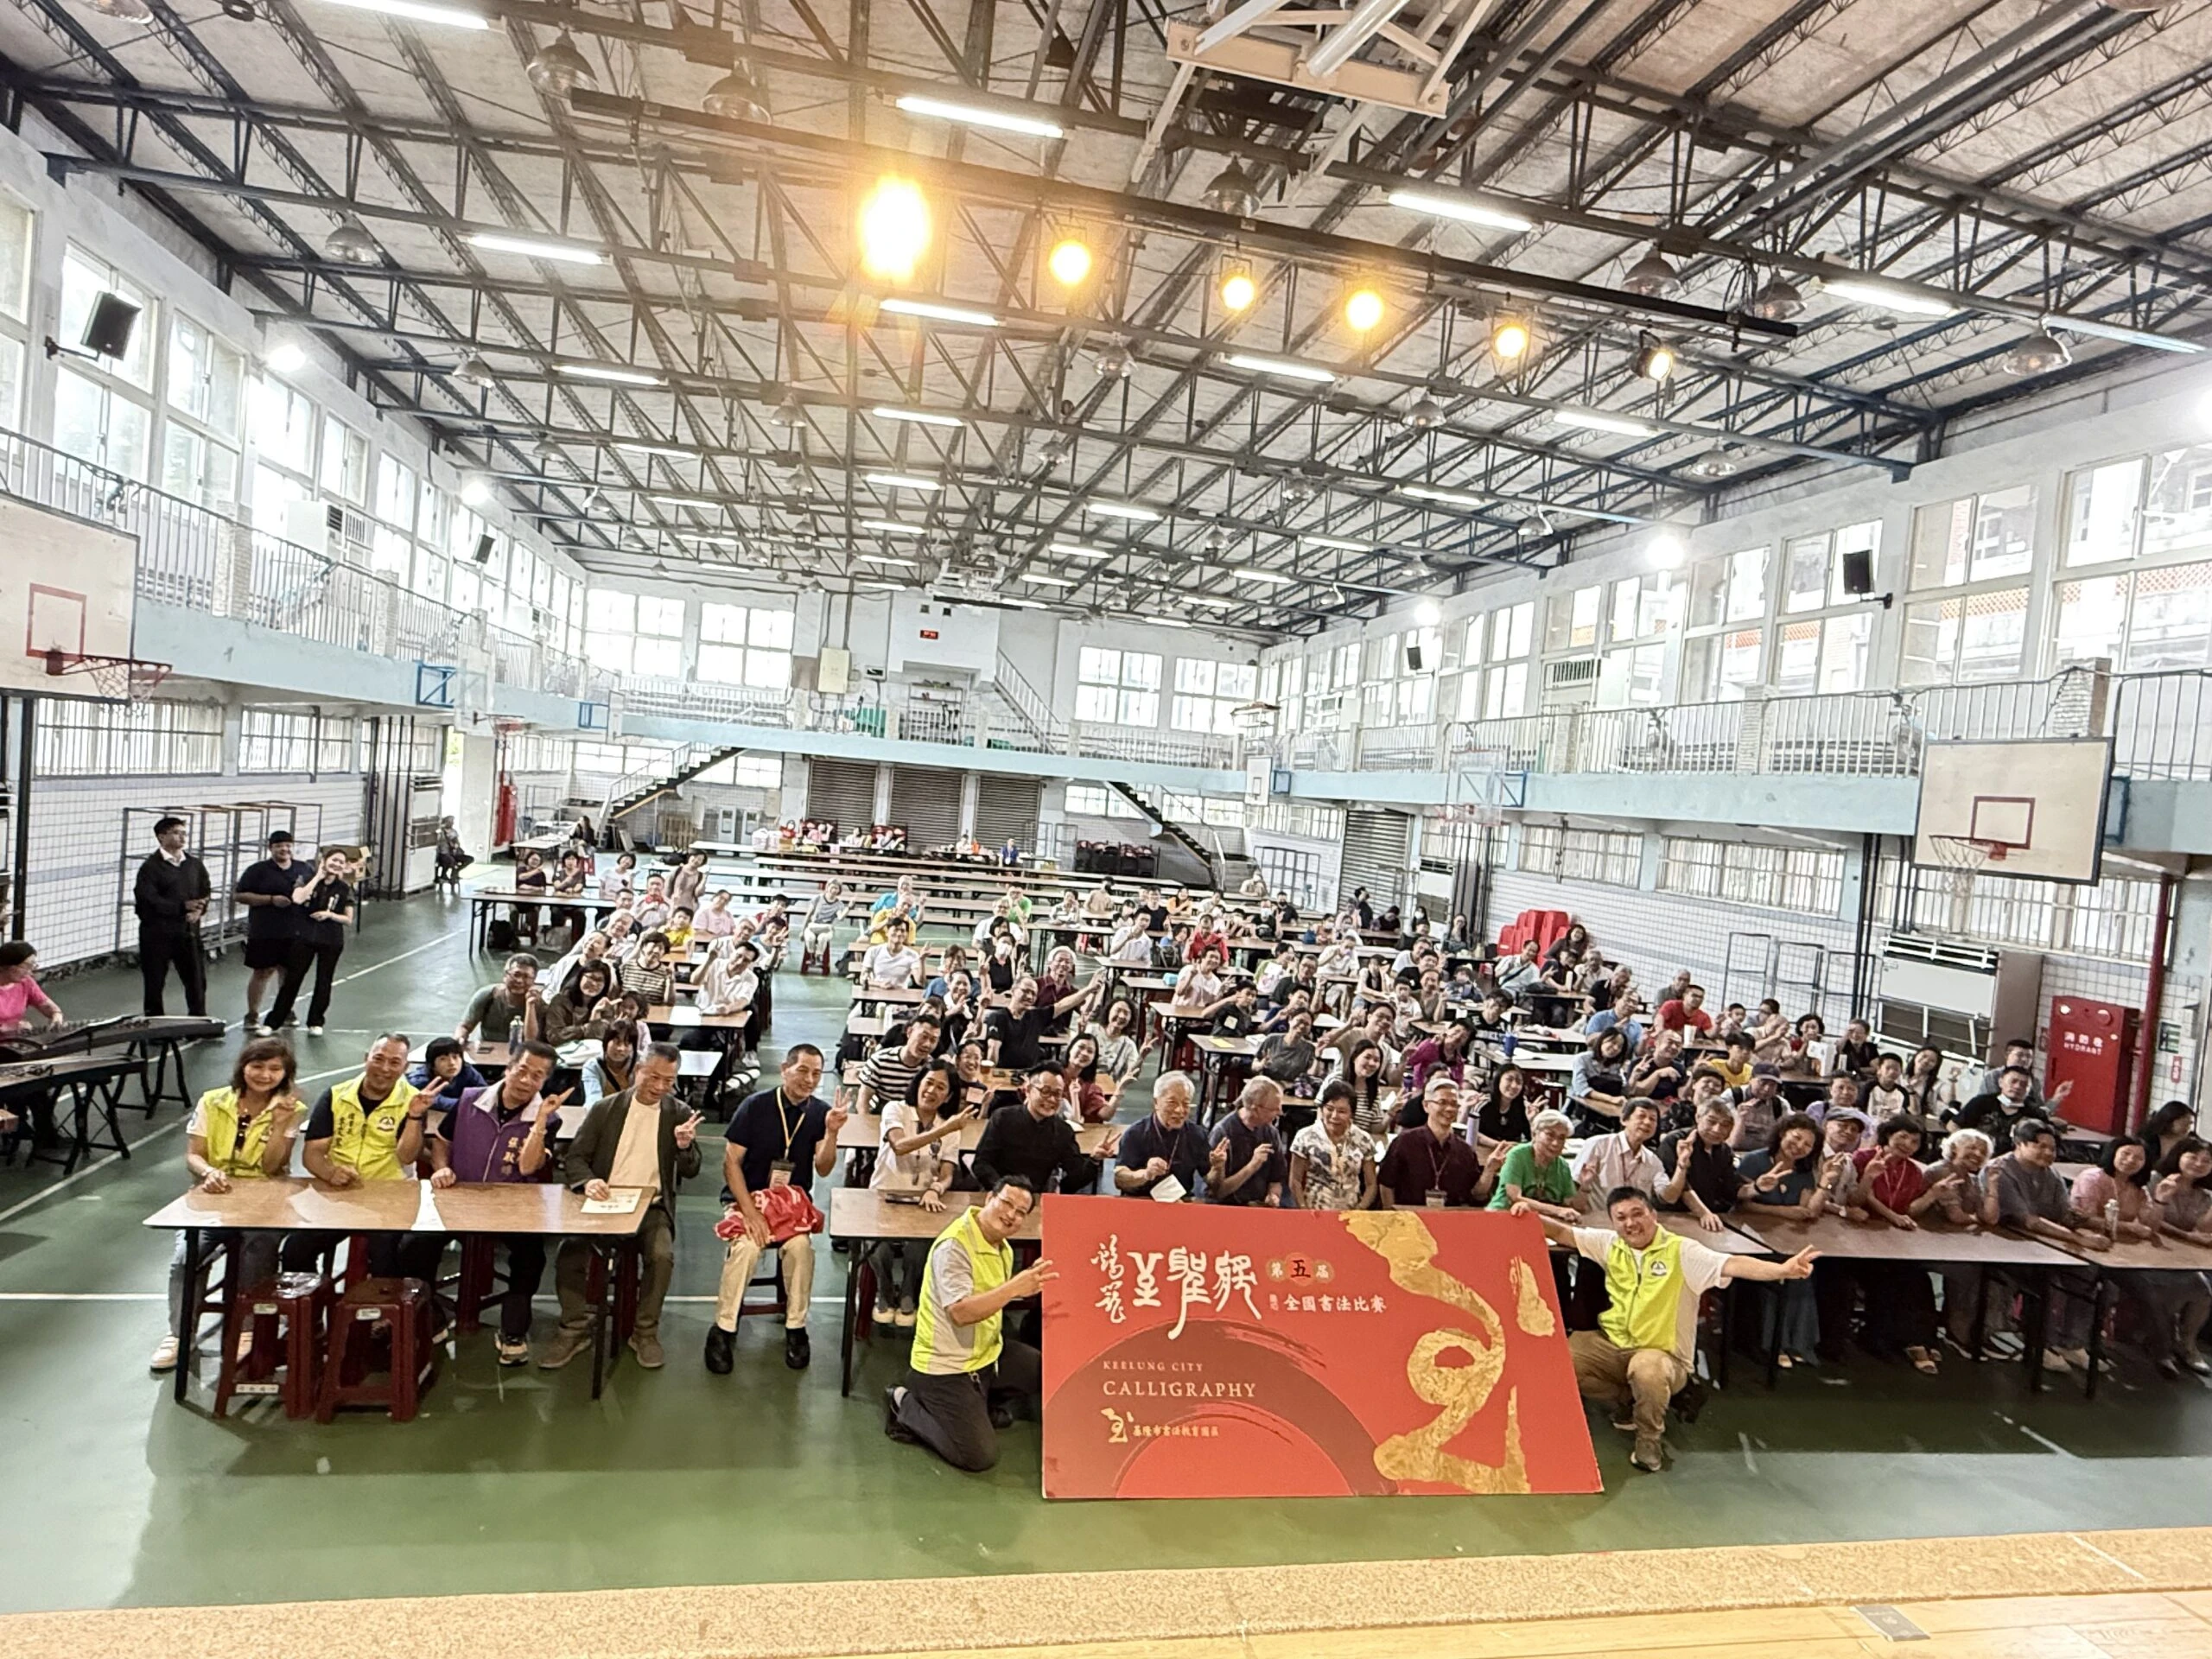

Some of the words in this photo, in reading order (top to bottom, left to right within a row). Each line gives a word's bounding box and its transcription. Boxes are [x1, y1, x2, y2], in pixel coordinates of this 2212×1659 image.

[2063, 1042, 2102, 1056] HYDRANT
[1271, 1259, 1330, 1279] 第五屆
[1284, 1294, 1387, 1313] 全國書法比賽
[1103, 1361, 1166, 1371] KEELUNG
[1171, 1362, 1204, 1372] CITY
[1103, 1381, 1256, 1397] CALLIGRAPHY
